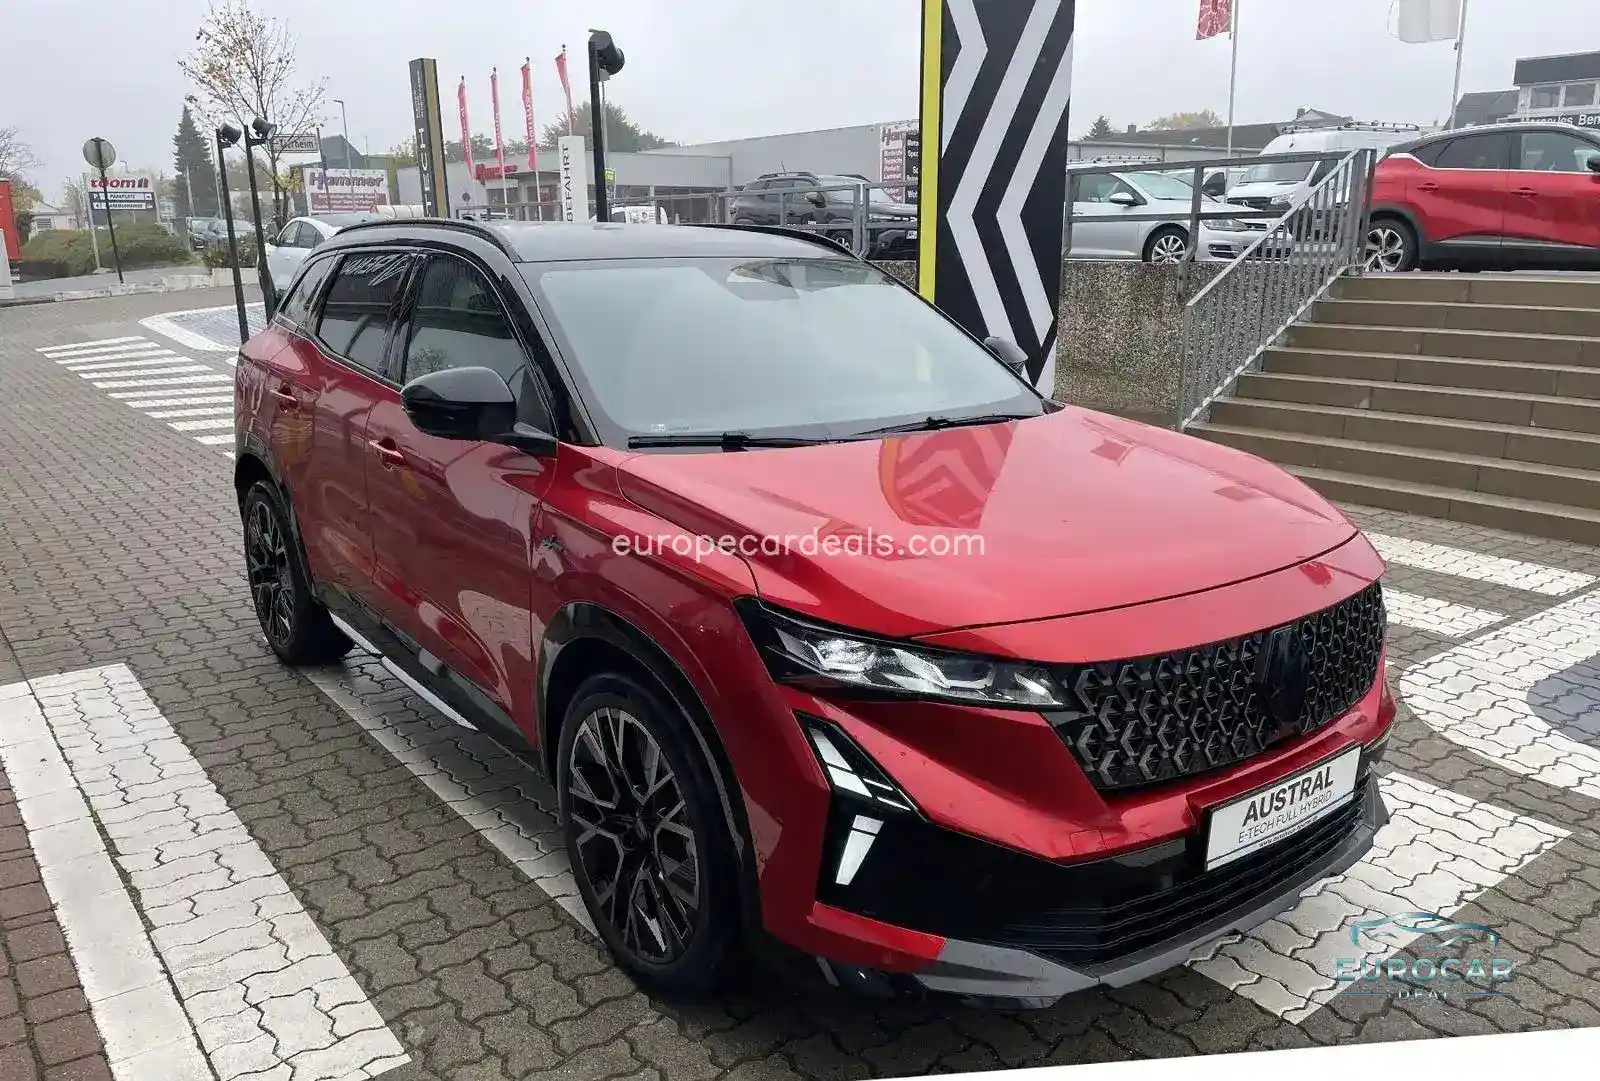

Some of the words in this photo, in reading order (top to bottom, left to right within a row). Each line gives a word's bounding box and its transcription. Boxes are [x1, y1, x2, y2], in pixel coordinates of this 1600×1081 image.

[1239, 817, 1275, 844] E-TECH
[1276, 808, 1298, 825] FULL
[1300, 791, 1332, 815] HYBRID
[1242, 766, 1334, 827] AUSTRAL
